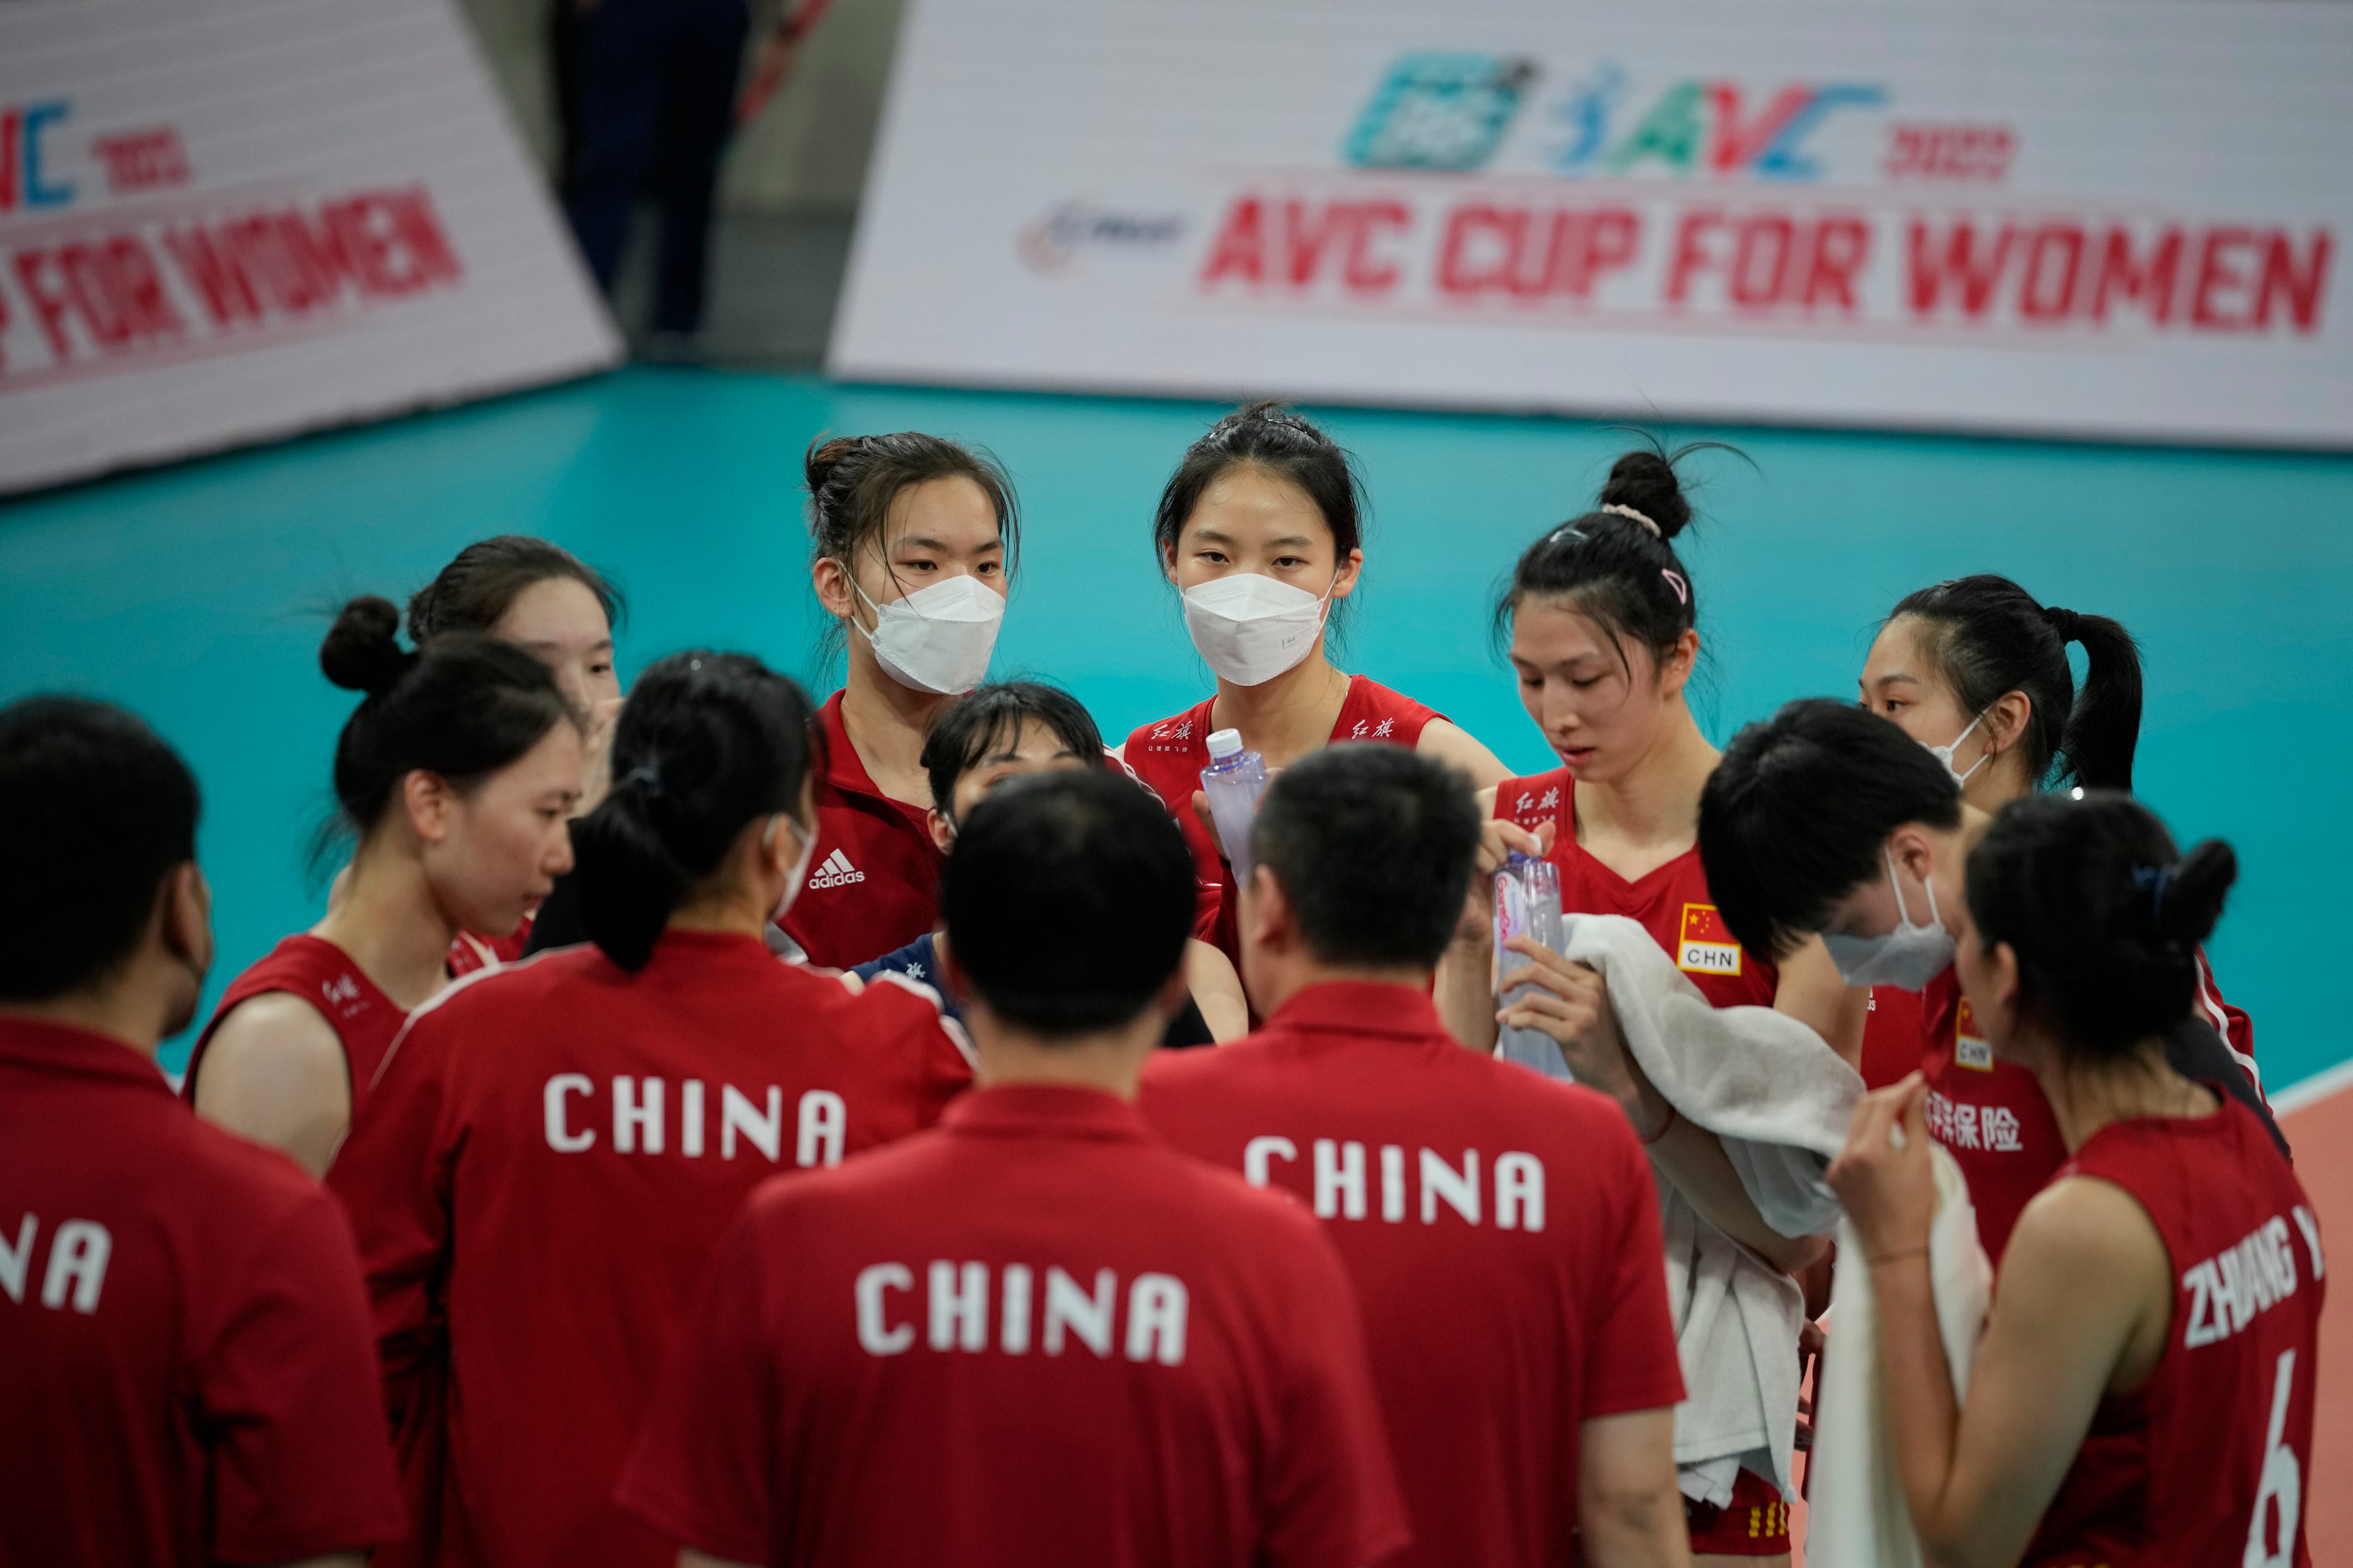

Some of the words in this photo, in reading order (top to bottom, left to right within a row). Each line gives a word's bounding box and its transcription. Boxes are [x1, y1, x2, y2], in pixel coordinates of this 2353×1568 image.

[1604, 83, 1887, 175] AVC
[1197, 193, 1414, 299] AVC
[1431, 199, 1644, 307] CUP
[1662, 208, 1874, 317] FOR
[1902, 216, 2335, 334] WOMEN
[1151, 721, 1194, 740] 红旗
[1352, 717, 1395, 739] 红旗
[808, 871, 865, 889] adidas
[1688, 949, 1731, 967] CHN
[543, 1073, 847, 1168] CHINA
[1243, 1135, 1546, 1233] CHINA
[854, 1259, 1189, 1367] CHINA
[2242, 1347, 2301, 1568] 6
